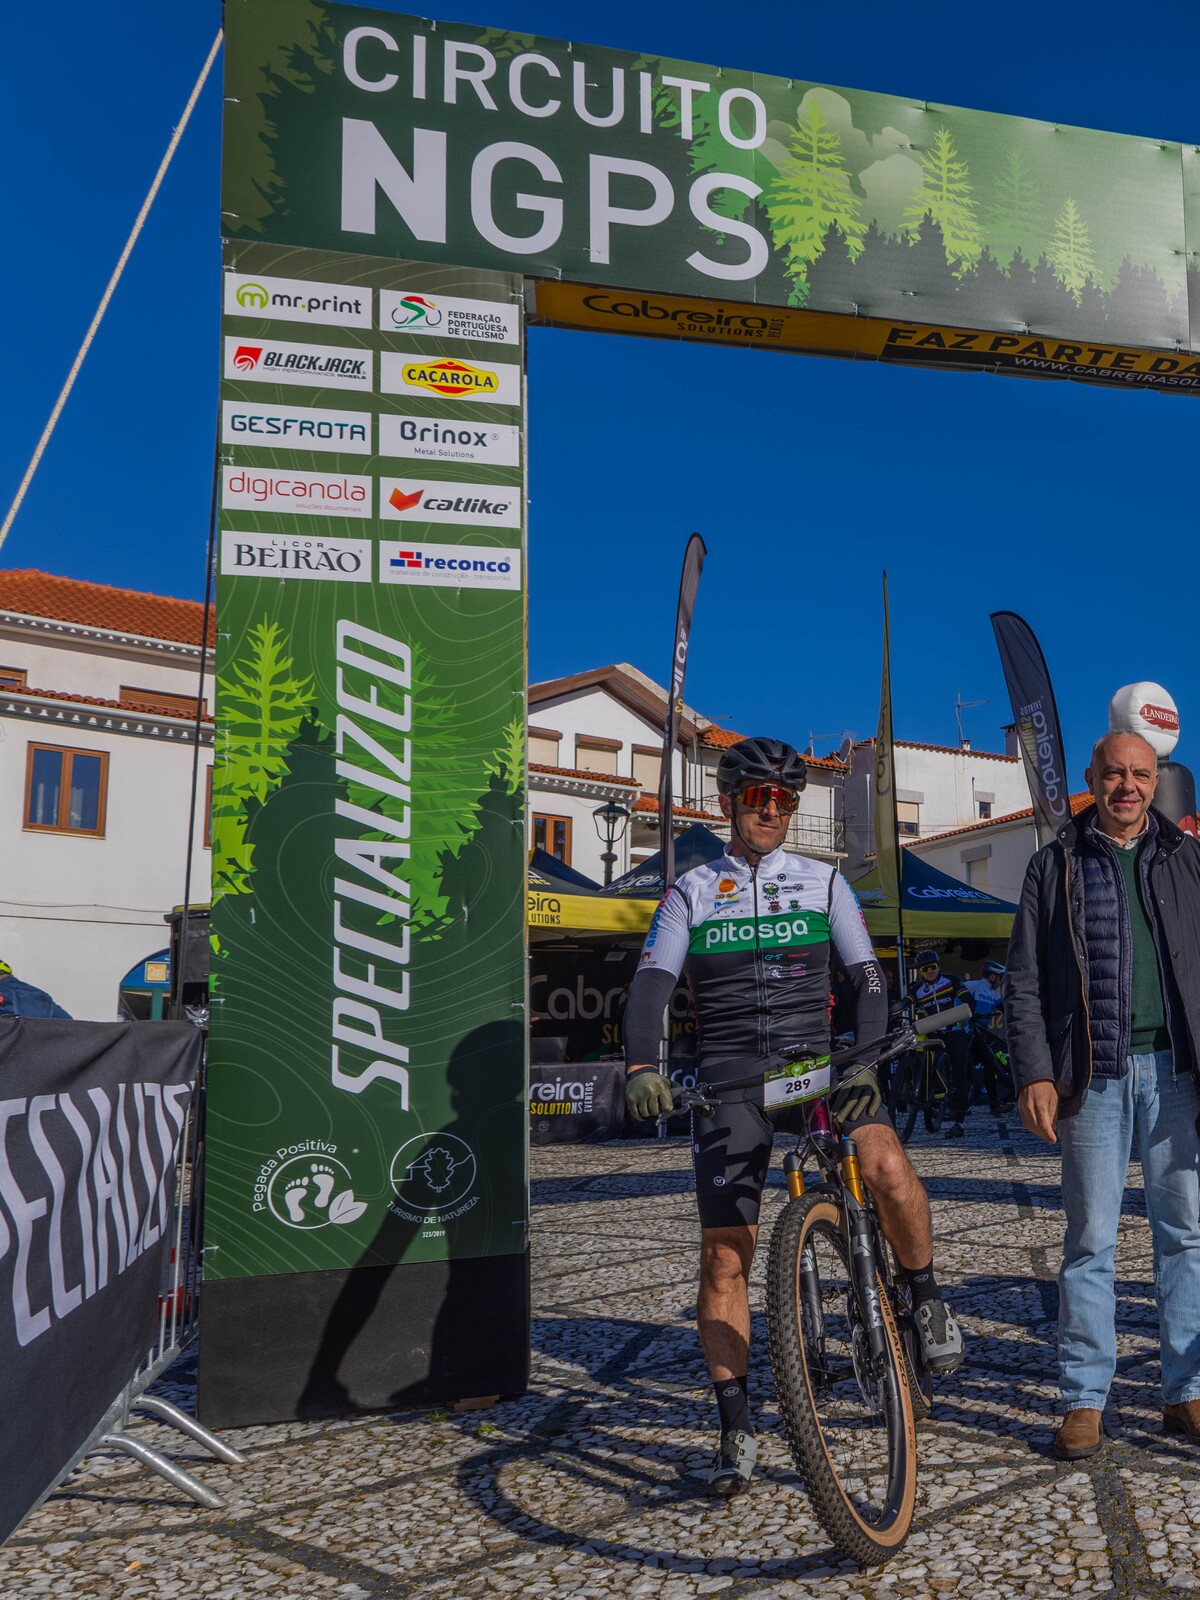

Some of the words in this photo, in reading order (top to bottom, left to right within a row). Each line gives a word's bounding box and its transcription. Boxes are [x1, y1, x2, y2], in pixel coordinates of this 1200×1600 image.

[343, 27, 767, 149] CIRCUITO
[341, 117, 769, 280] NGPS
[272, 293, 362, 315] mr.print
[582, 295, 768, 330] Cabreira
[448, 309, 502, 324] FEDERAÇÃO
[448, 319, 508, 333] PORTUGUESA
[448, 327, 462, 336] DE
[463, 328, 505, 340] CICLISMO
[677, 322, 764, 338] SOLUTIONS
[887, 327, 980, 350] FAZ
[988, 336, 1141, 370] PARTE
[263, 351, 366, 375] BLACKJACK
[282, 368, 336, 377] PERFORMANCE
[407, 368, 494, 388] CAÇAROLA
[231, 414, 366, 442] GESFROTA
[400, 421, 488, 447] Brinox
[414, 447, 436, 457] Metal
[437, 449, 475, 460] Solutions
[229, 472, 366, 502] digicanola
[296, 503, 322, 512] soluções
[323, 504, 362, 513] documentais
[423, 497, 508, 515] catlike
[272, 539, 324, 549] LICOR
[233, 543, 361, 573] BEIRÃO
[425, 557, 511, 573] reconco
[389, 569, 420, 577] materiais
[432, 572, 468, 580] construção
[473, 574, 511, 582] transportes
[332, 619, 412, 1111] SPECIALIZED
[908, 886, 992, 900] Cabreira
[706, 920, 809, 948] pitosga
[584, 1081, 594, 1113] EVENTOS
[786, 1079, 811, 1094] 289
[253, 1158, 278, 1212] Pegada
[276, 1139, 338, 1160] Positiva
[386, 1201, 422, 1224] TURISMO
[423, 1216, 437, 1224] DE
[438, 1195, 481, 1223] NATUREZA
